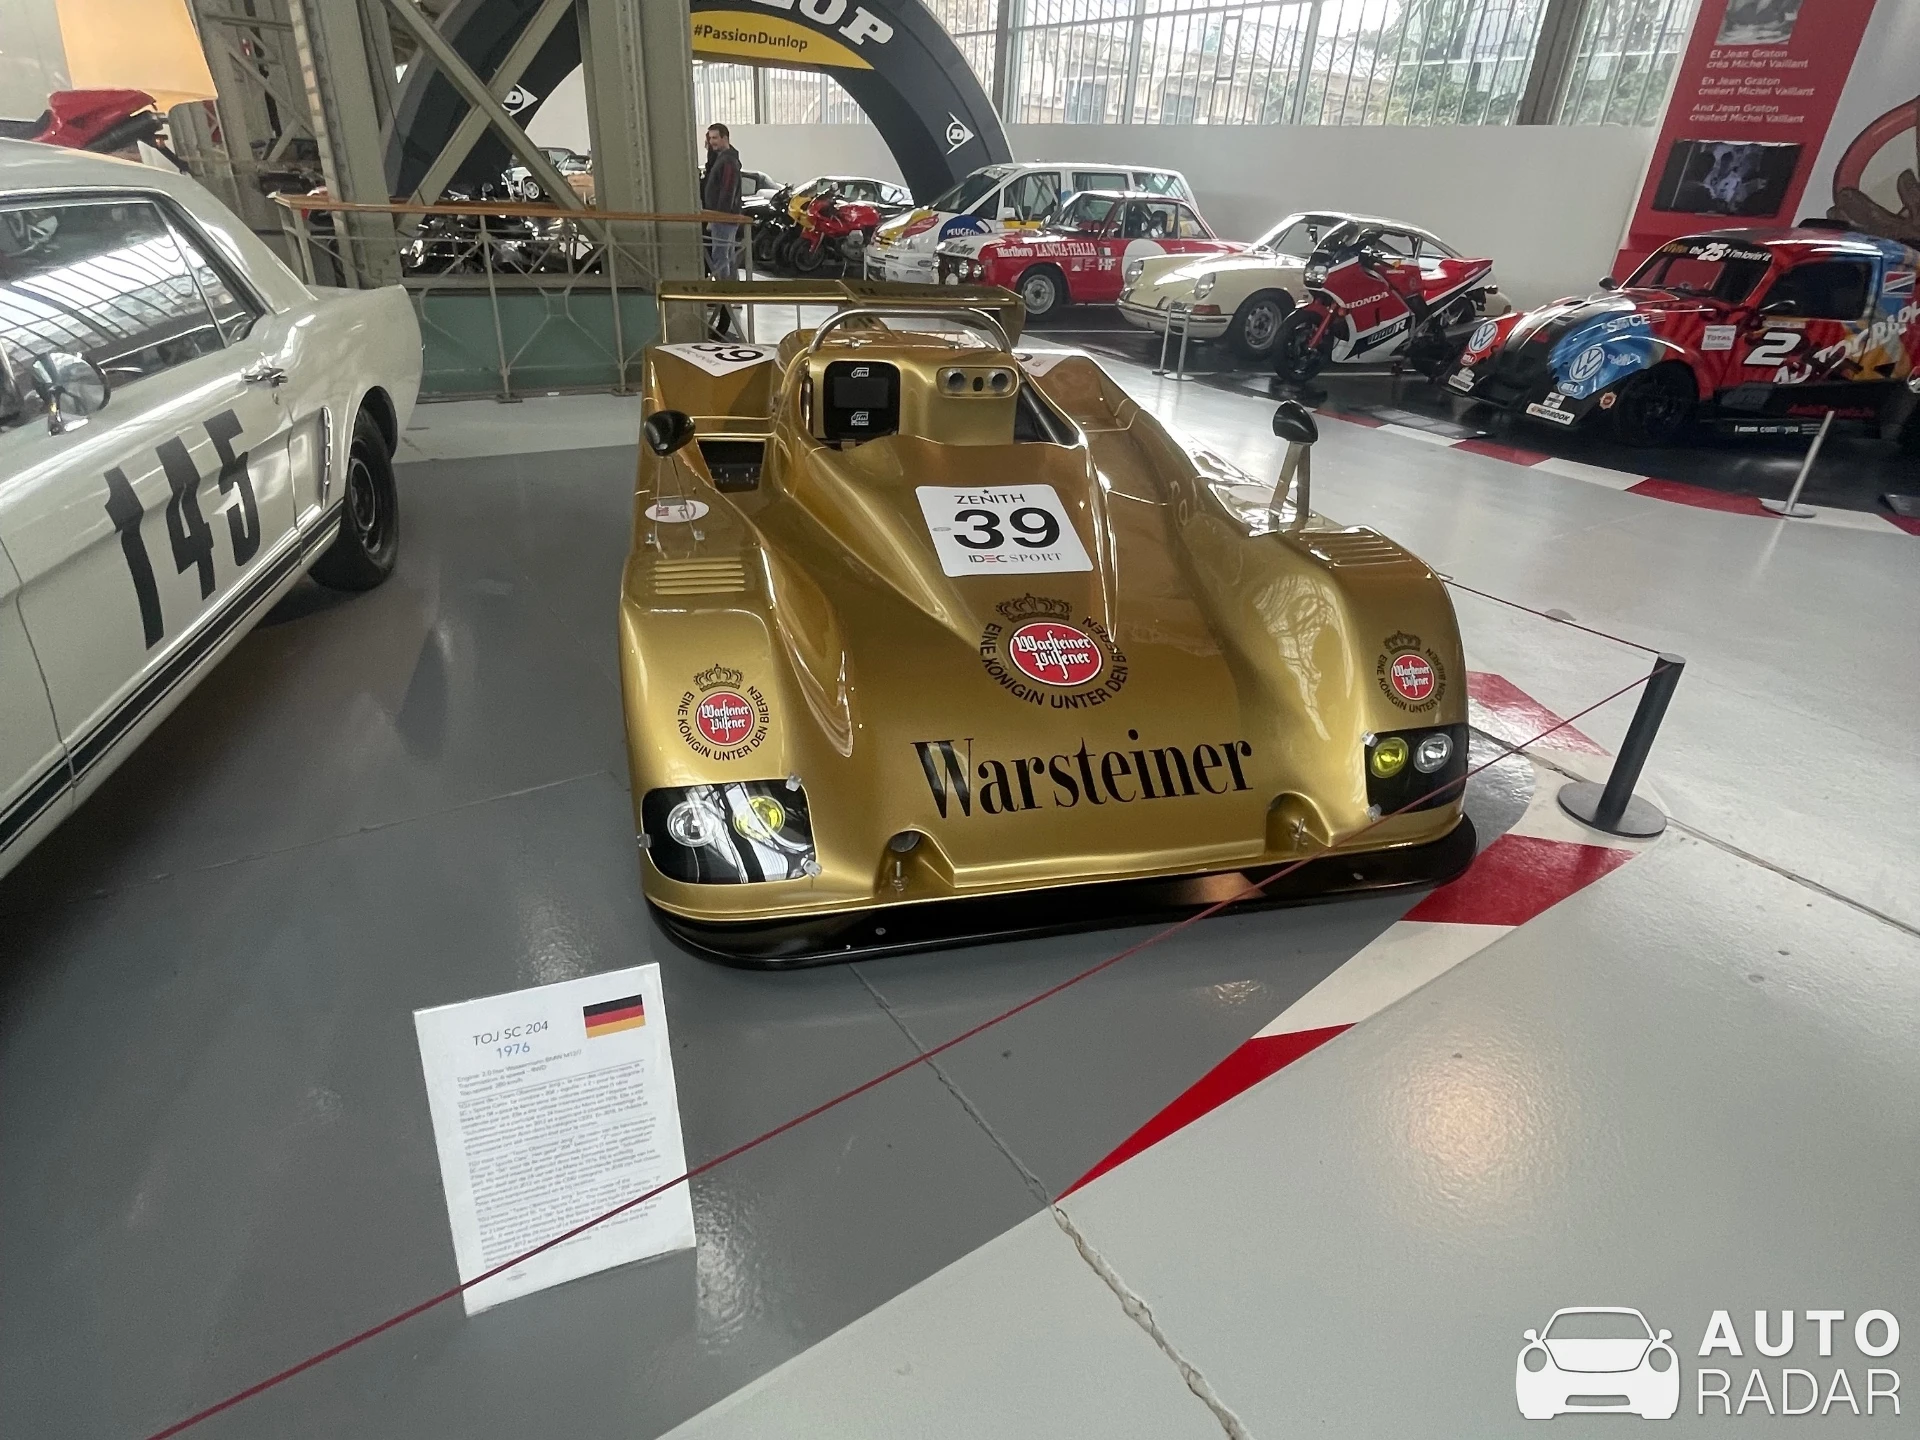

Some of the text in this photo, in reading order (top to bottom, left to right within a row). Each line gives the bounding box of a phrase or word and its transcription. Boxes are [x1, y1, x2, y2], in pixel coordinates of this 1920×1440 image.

[749, 0, 894, 46] OP
[693, 24, 808, 52] #PassionDunlop
[1724, 50, 1749, 58] Jean
[1752, 50, 1787, 58] Graton
[1731, 60, 1766, 68] Michel
[1769, 59, 1808, 69] Vaillant
[1702, 77, 1780, 85] En Jean Graton
[1737, 87, 1771, 96] Michel
[1775, 87, 1815, 96] Vaillant
[1689, 114, 1804, 123] created Michel Vaillant
[1692, 104, 1779, 112] And Jean Graton
[996, 246, 1033, 257] Marlboro
[1345, 291, 1389, 309] HONDA
[1744, 332, 1801, 366] 2
[954, 493, 1025, 505] ZENITH
[103, 408, 261, 650] 145
[953, 507, 1060, 550] 39
[968, 552, 1062, 563] IDEC SPORT
[980, 622, 1002, 656] EINE
[982, 658, 1045, 706] KÖNIGIN
[1105, 665, 1128, 692] DEN
[1376, 654, 1388, 675] EINE
[1409, 699, 1438, 713] UNTER
[1435, 682, 1446, 702] DEN
[1050, 687, 1112, 709] UNTER
[677, 685, 770, 761] EINE KÖNIGIN UNTER DEN BIEREN
[910, 728, 1254, 819] Warsteiner
[472, 1020, 549, 1046] TOJ SC 204
[496, 1042, 531, 1059] 1976
